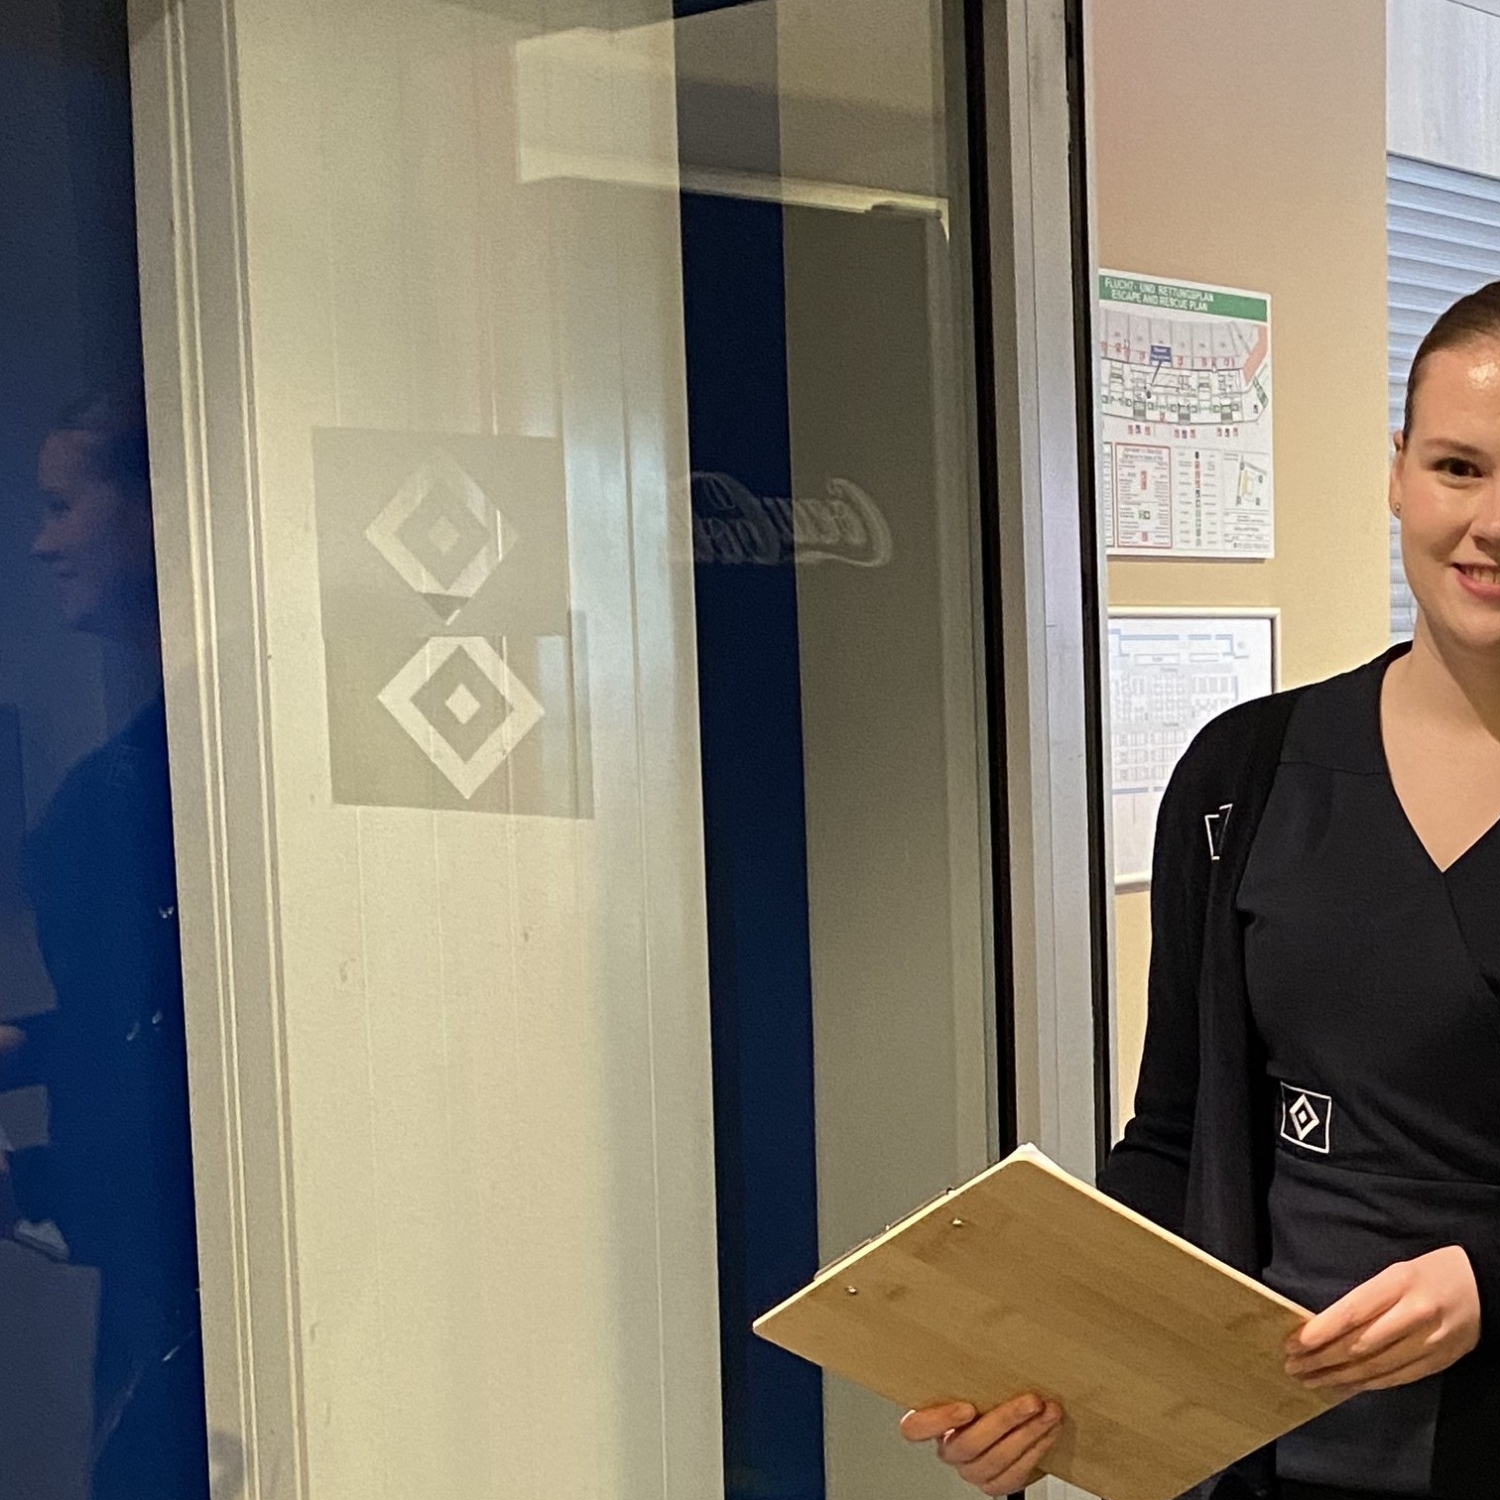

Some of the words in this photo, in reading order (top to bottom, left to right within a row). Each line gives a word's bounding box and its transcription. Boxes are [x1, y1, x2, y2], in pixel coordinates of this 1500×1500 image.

[1139, 283, 1156, 294] UND
[1112, 289, 1142, 303] ESCAPE
[1143, 294, 1158, 305] AND
[1159, 296, 1188, 309] RESCUE
[1189, 300, 1208, 311] PLAN
